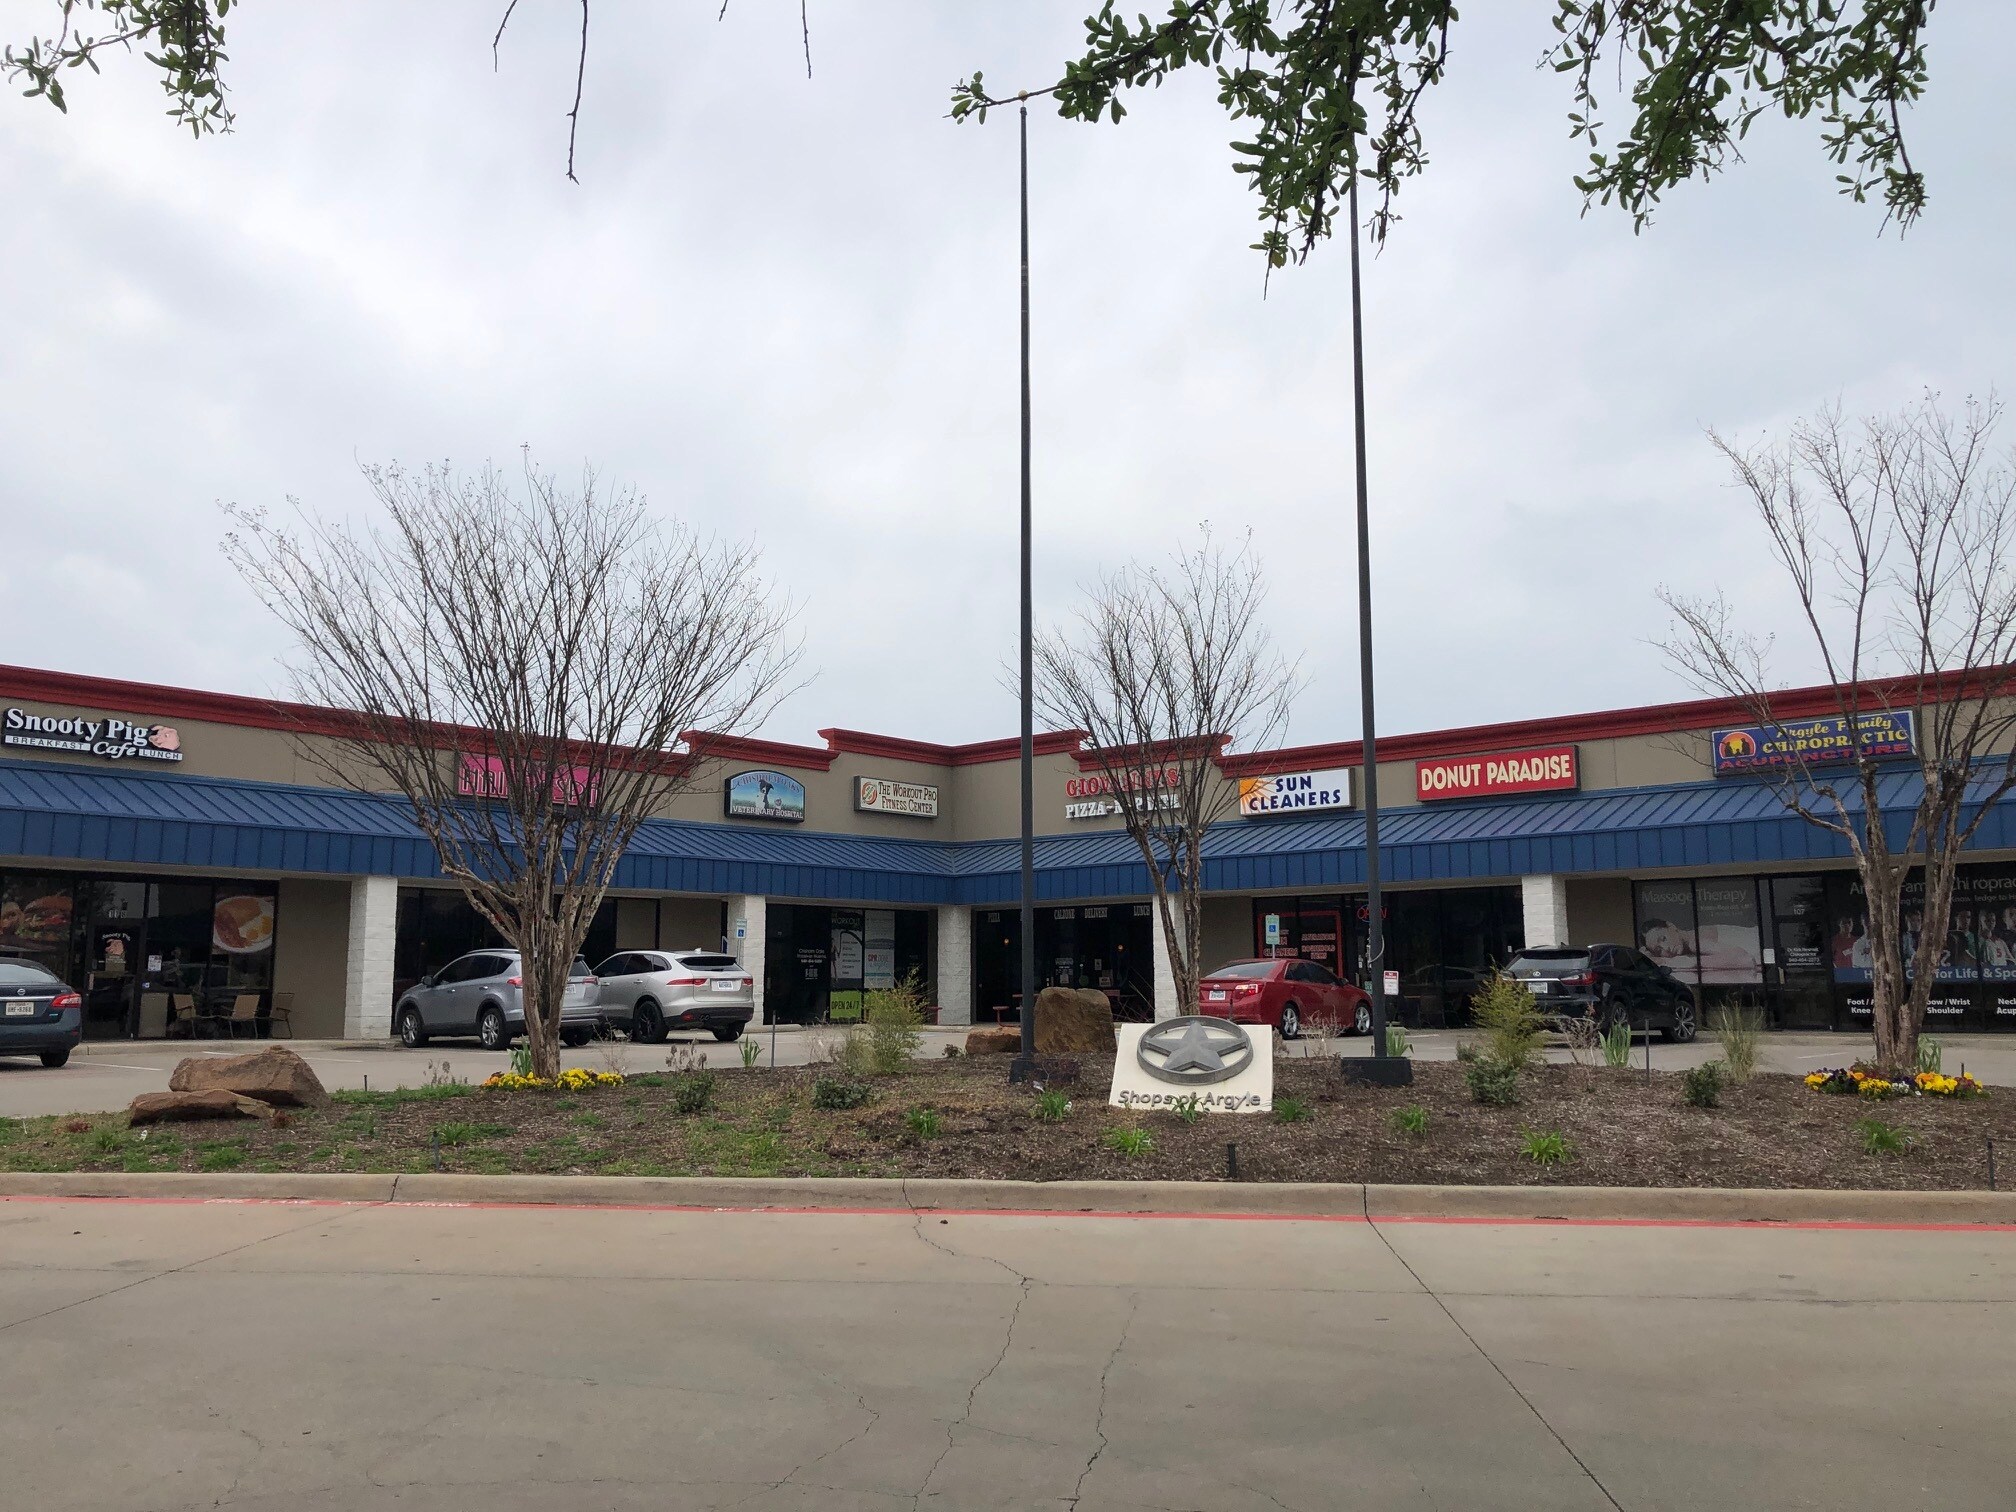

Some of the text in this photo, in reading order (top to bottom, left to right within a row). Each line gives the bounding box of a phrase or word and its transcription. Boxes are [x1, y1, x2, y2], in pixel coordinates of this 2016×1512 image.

[6, 708, 149, 747] Snooty Pig
[1776, 716, 1892, 739] Argyle Fmily
[12, 737, 179, 760] BREAKFAST Cafe LUNCH
[1762, 729, 1909, 754] CHROPRCTIC
[1421, 754, 1572, 791] DONUT PARADISE
[878, 782, 937, 801] THE WORKOUT PRO
[1275, 775, 1312, 793] SUN
[882, 796, 933, 814] FITNESS CENTER
[1249, 788, 1341, 812] CLEANERS
[733, 805, 804, 819] VETERINARY HOSPITAL
[1641, 888, 1747, 905] Massage Therapy
[1357, 907, 1387, 920] OPN
[1263, 947, 1299, 957] CLANERS
[1935, 968, 1952, 979] for
[1955, 968, 1979, 979] Life
[1982, 968, 1993, 979] &
[1847, 998, 1865, 1006] Foot
[1949, 998, 1971, 1006] Wrist
[1118, 1089, 1173, 1107] Shops
[1203, 1090, 1262, 1110] Argyle
